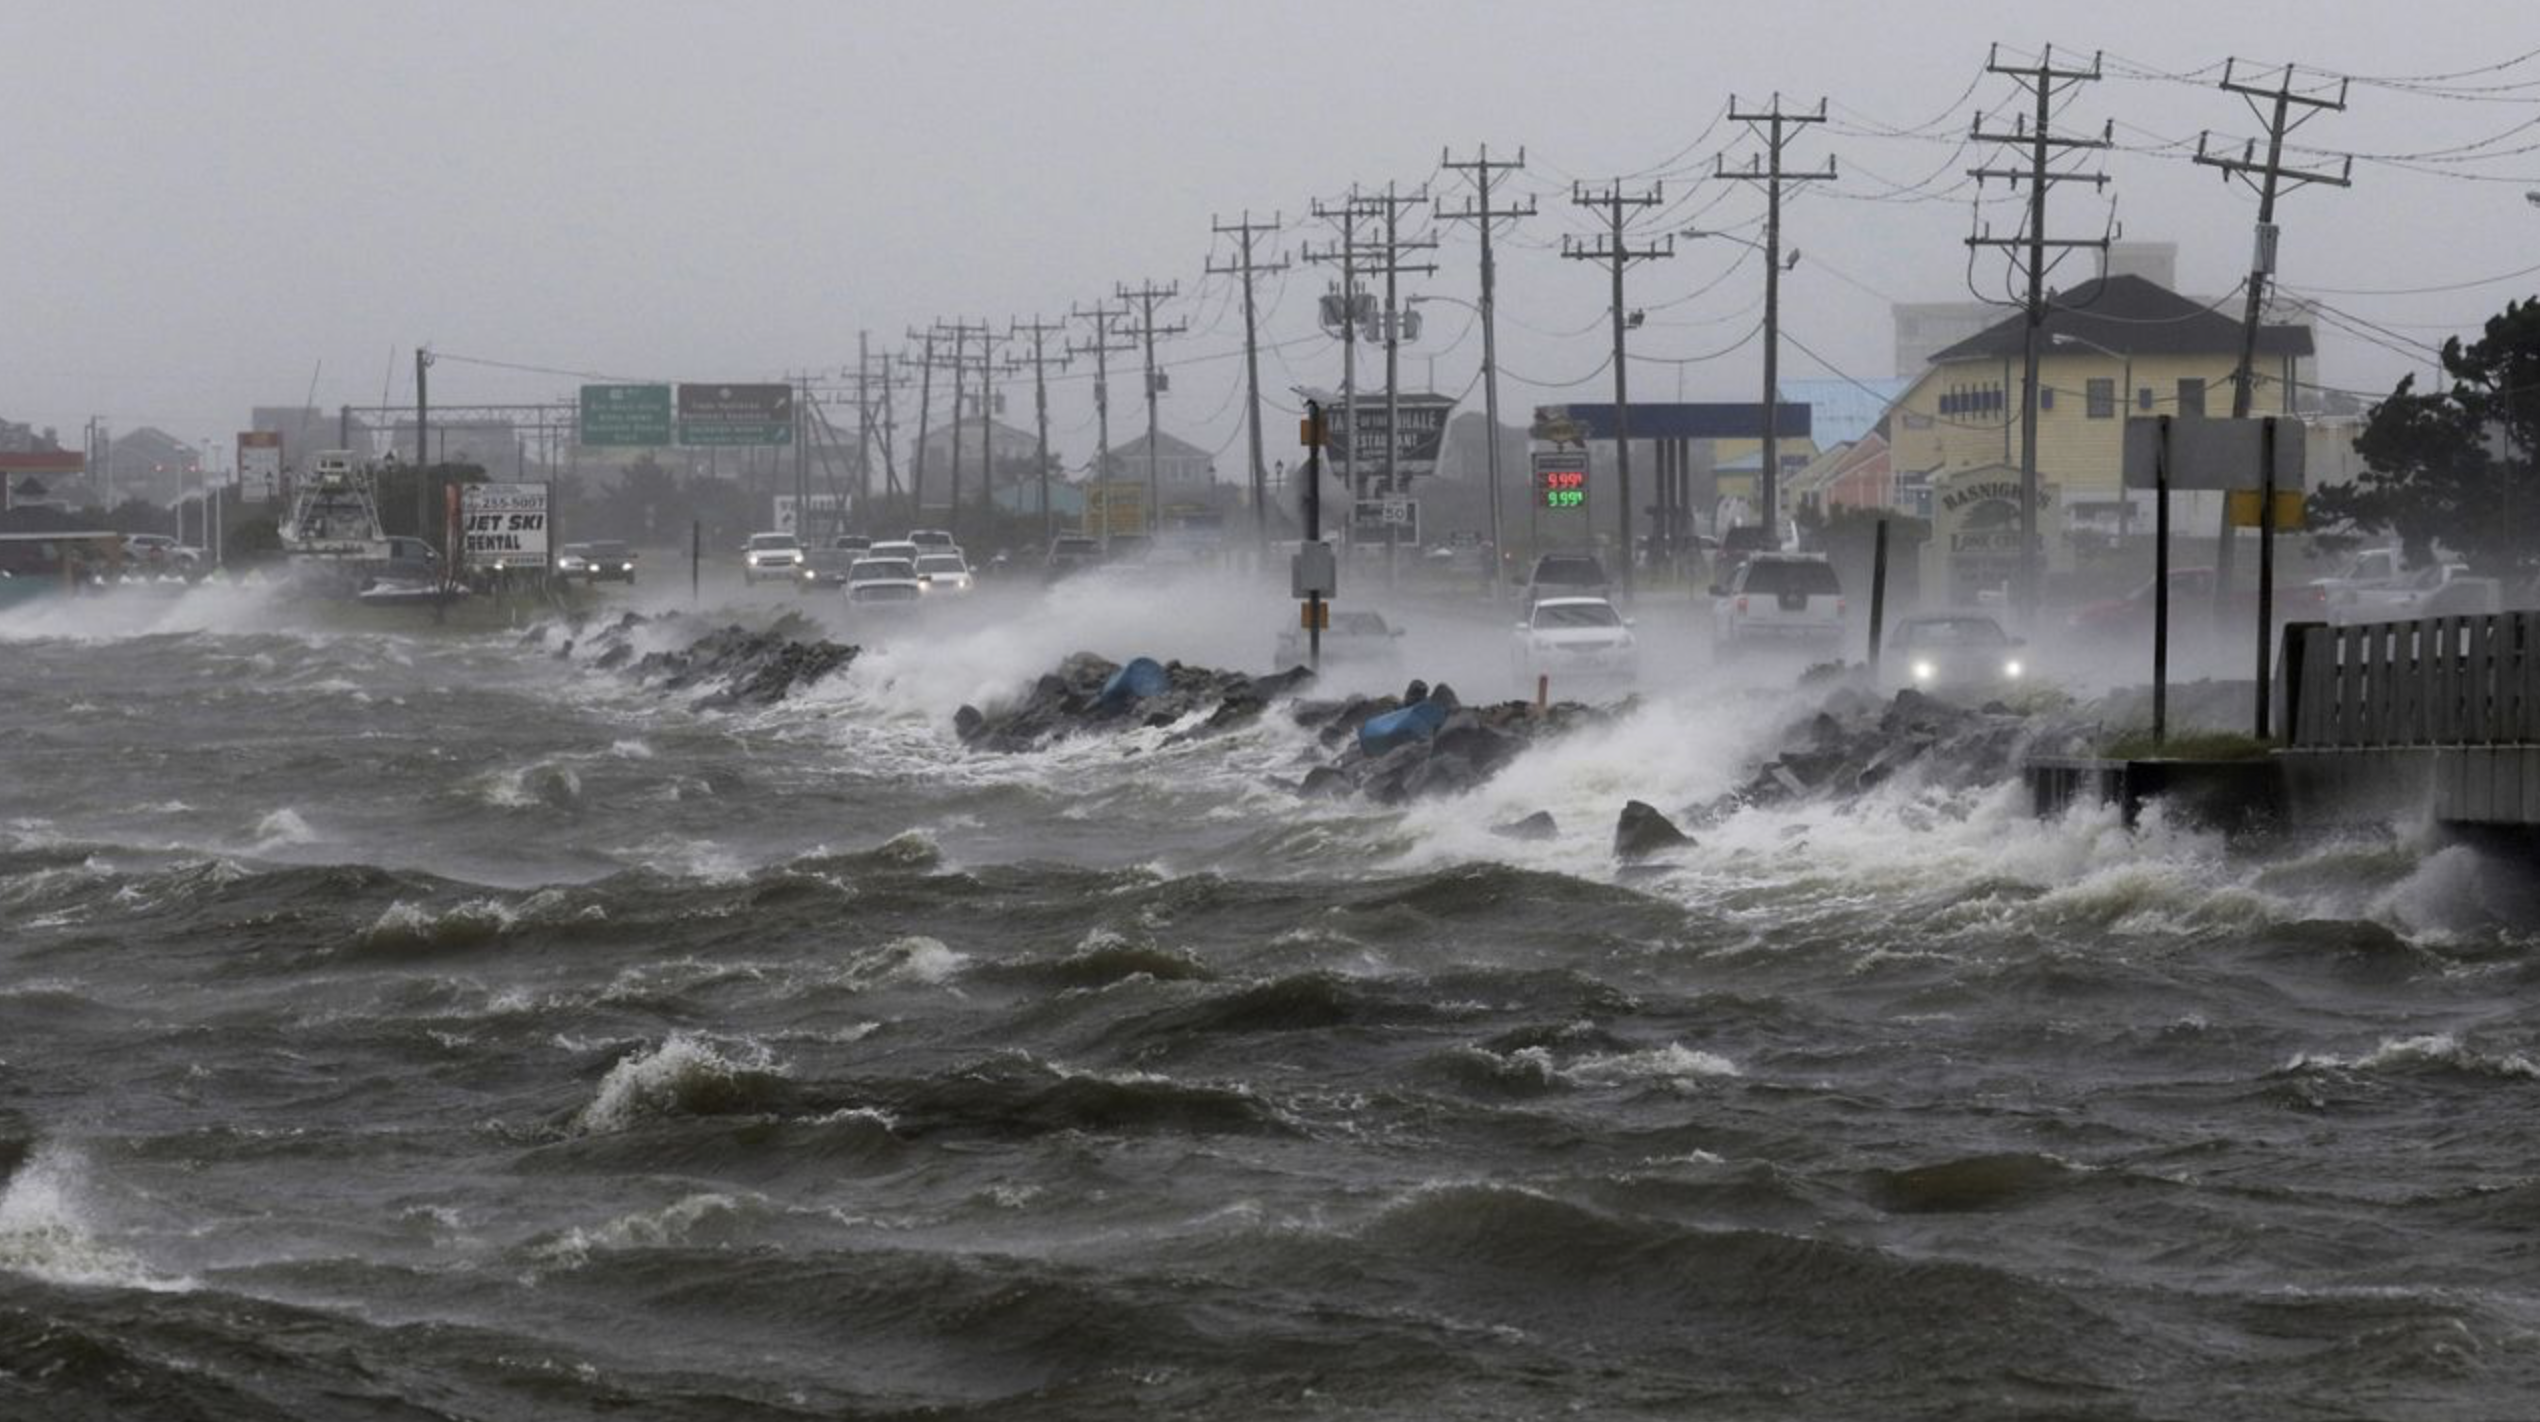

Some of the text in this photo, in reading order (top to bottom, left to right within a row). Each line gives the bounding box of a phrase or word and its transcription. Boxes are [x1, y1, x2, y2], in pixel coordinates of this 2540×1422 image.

[1350, 433, 1417, 447] ESTAUANT
[1943, 482, 2051, 511] BASNIGH'S
[467, 514, 543, 531] JET SKI
[467, 534, 520, 551] RENTAL
